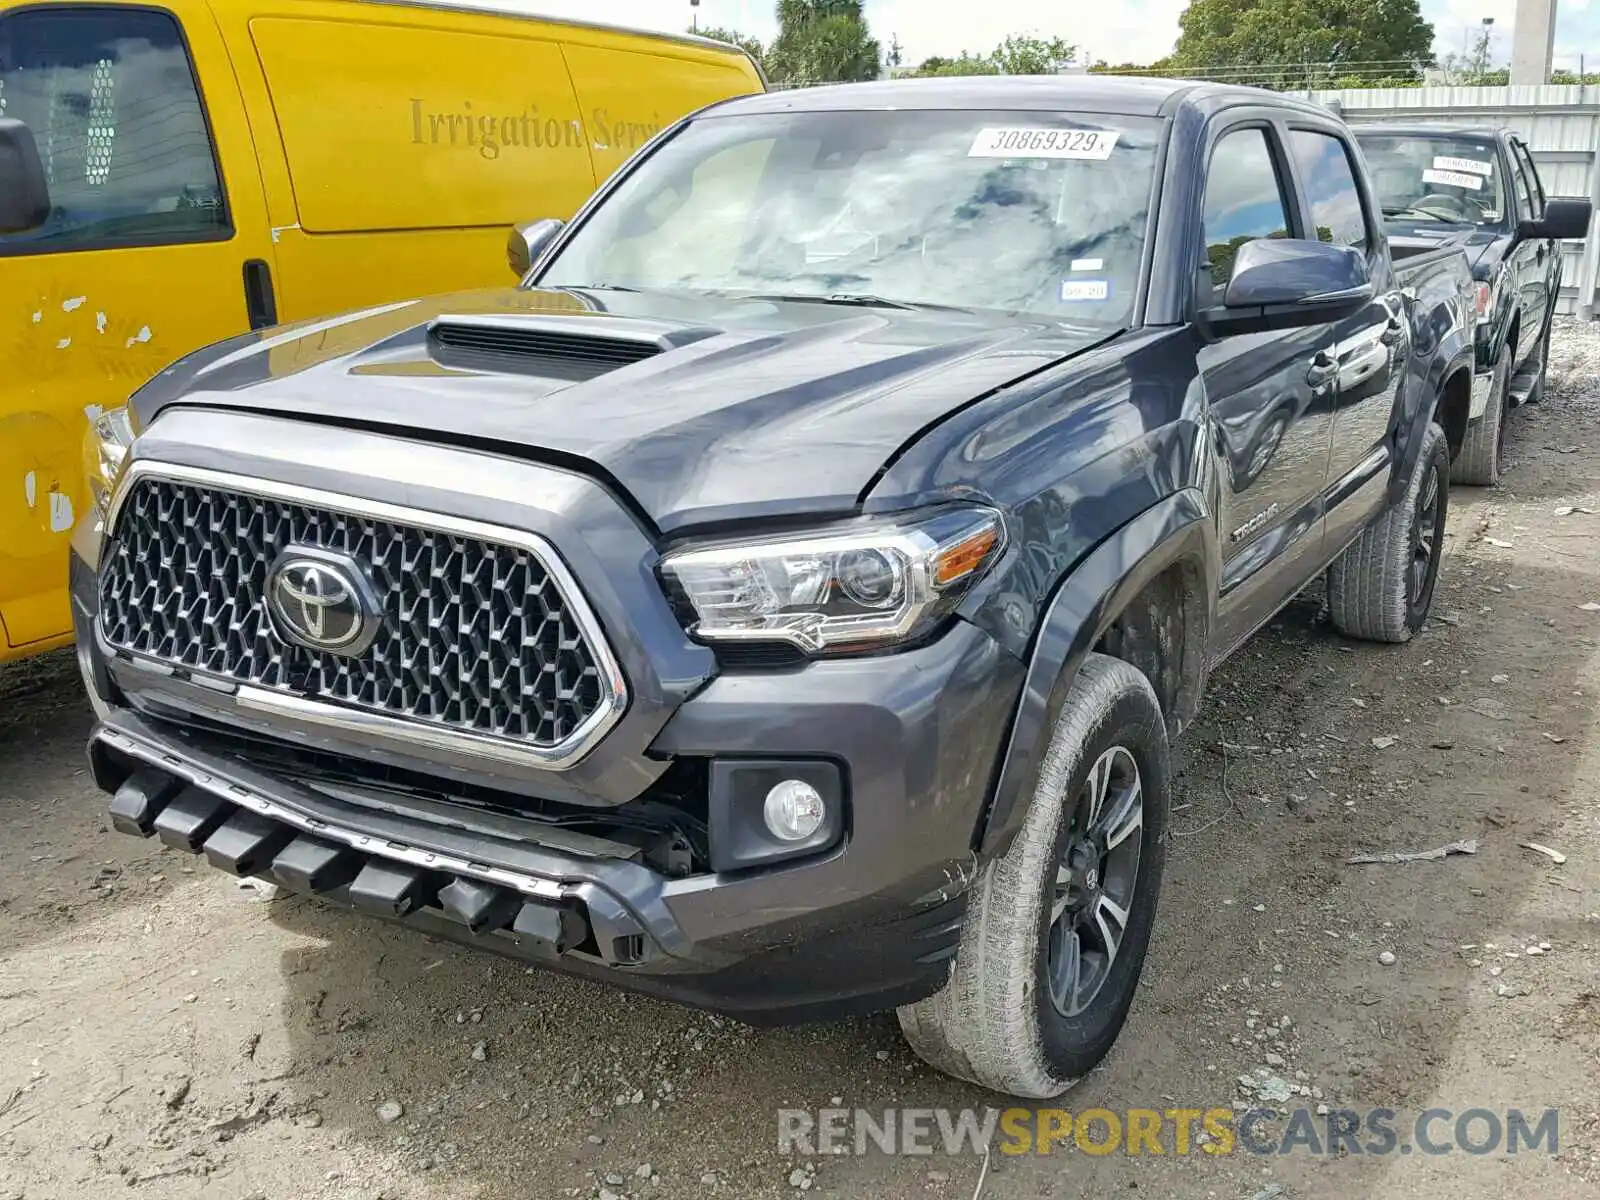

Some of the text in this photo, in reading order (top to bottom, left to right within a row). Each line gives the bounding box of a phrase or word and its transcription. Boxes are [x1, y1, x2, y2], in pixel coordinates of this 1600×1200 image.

[410, 98, 583, 160] Irrigation
[991, 130, 1099, 152] 30869329
[1230, 502, 1278, 543] TACOMA
